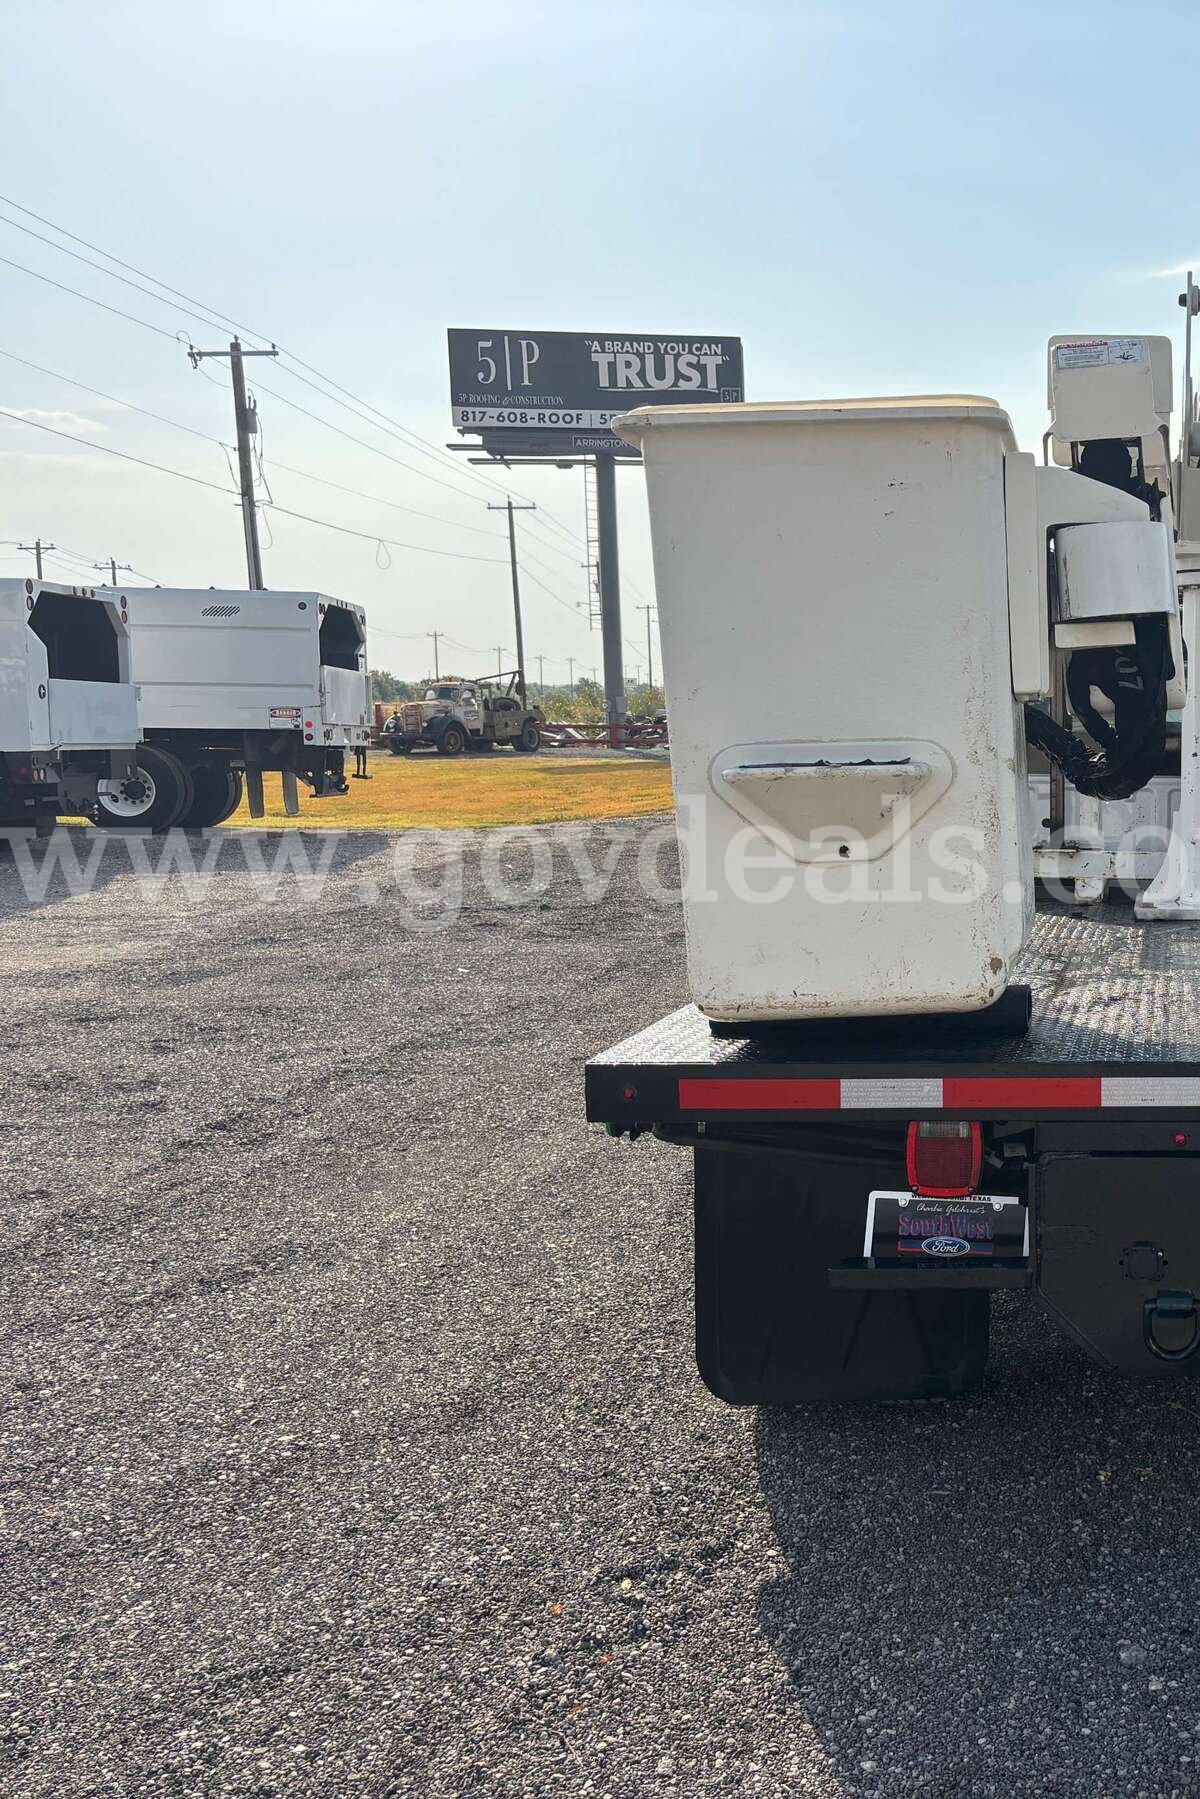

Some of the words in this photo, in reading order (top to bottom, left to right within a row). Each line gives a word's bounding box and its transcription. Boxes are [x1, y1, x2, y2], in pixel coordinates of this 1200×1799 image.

[605, 341, 653, 353] BRAND
[657, 342, 688, 354] YOU
[692, 343, 721, 355] CAN
[511, 395, 564, 405] CONSTRUCTION
[460, 410, 583, 425] 817-608-ROOF
[932, 1240, 960, 1253] Ford
